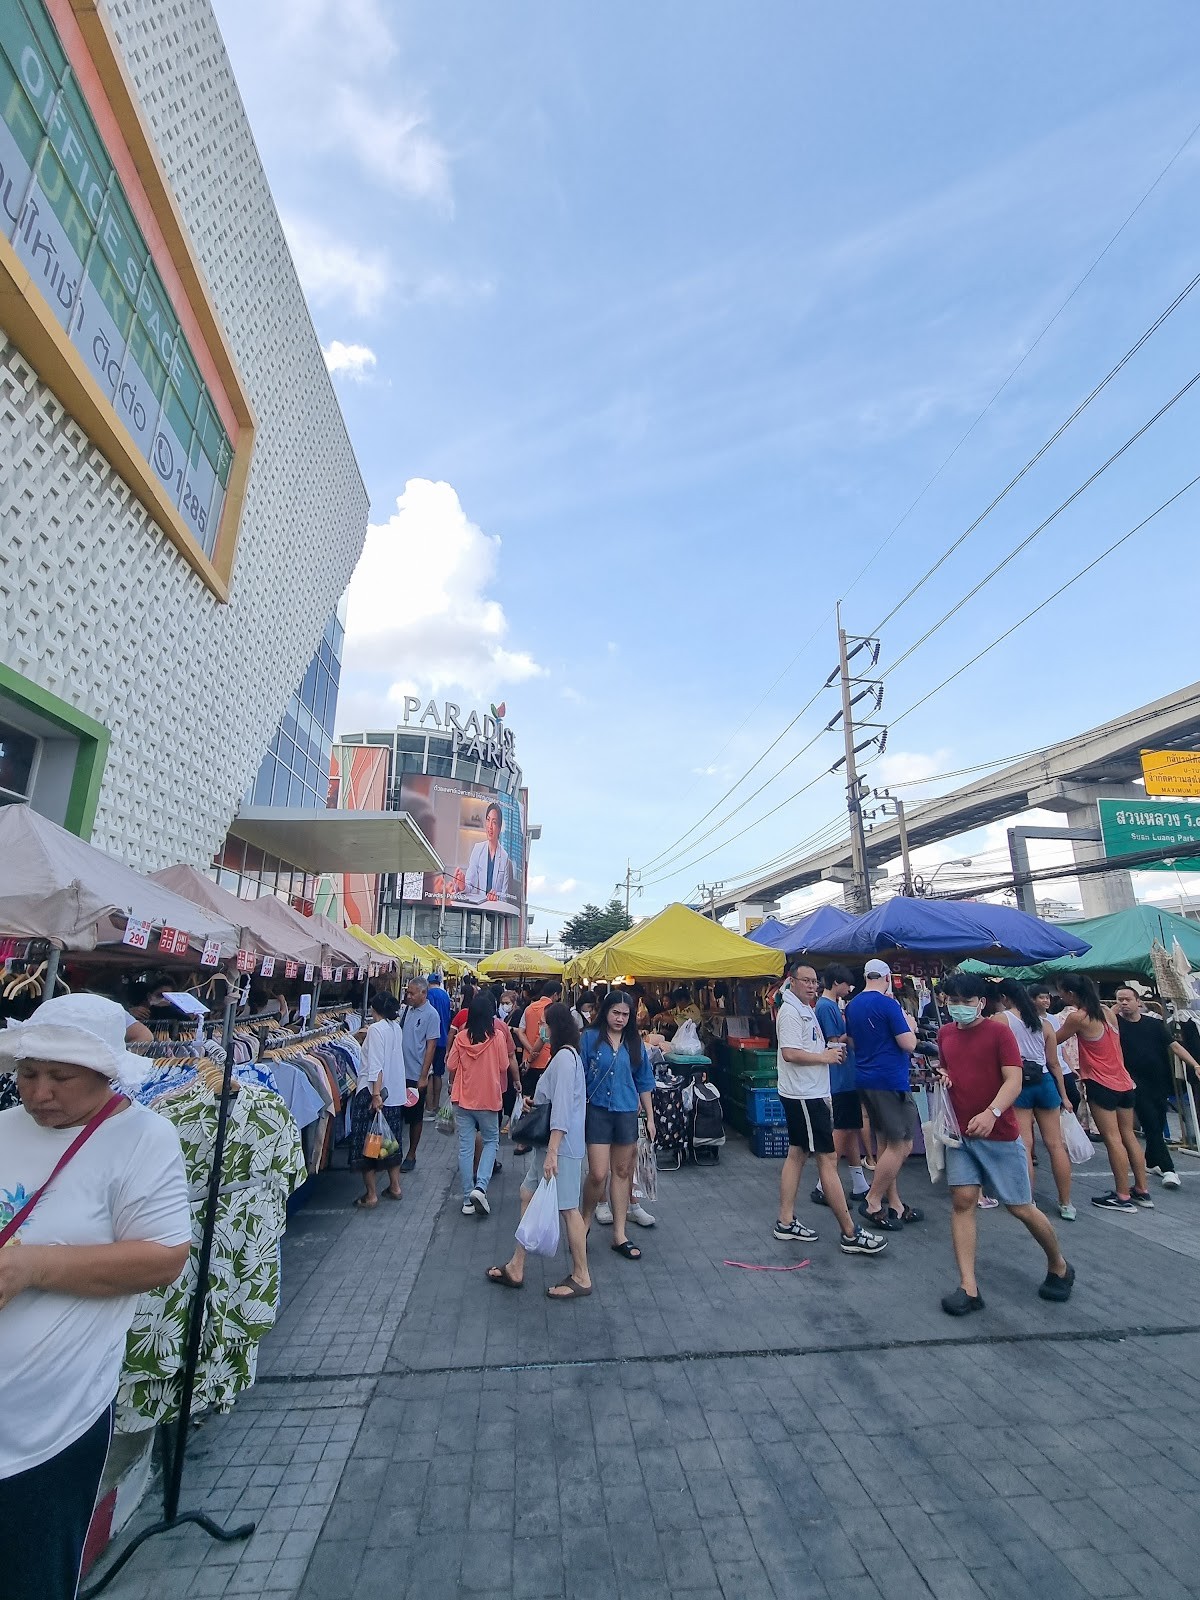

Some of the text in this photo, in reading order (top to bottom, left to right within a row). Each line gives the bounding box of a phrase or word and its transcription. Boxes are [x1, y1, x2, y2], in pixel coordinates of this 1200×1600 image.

[21, 46, 185, 388] OFFICE SPACE
[93, 327, 147, 432] ติดต่อ
[176, 468, 208, 533] 1285
[452, 728, 515, 774] PARK
[1116, 810, 1181, 827] สวนหลวง
[1152, 833, 1175, 843] Luang
[1177, 834, 1195, 842] Park
[129, 931, 145, 946] 290
[205, 954, 217, 965] 200
